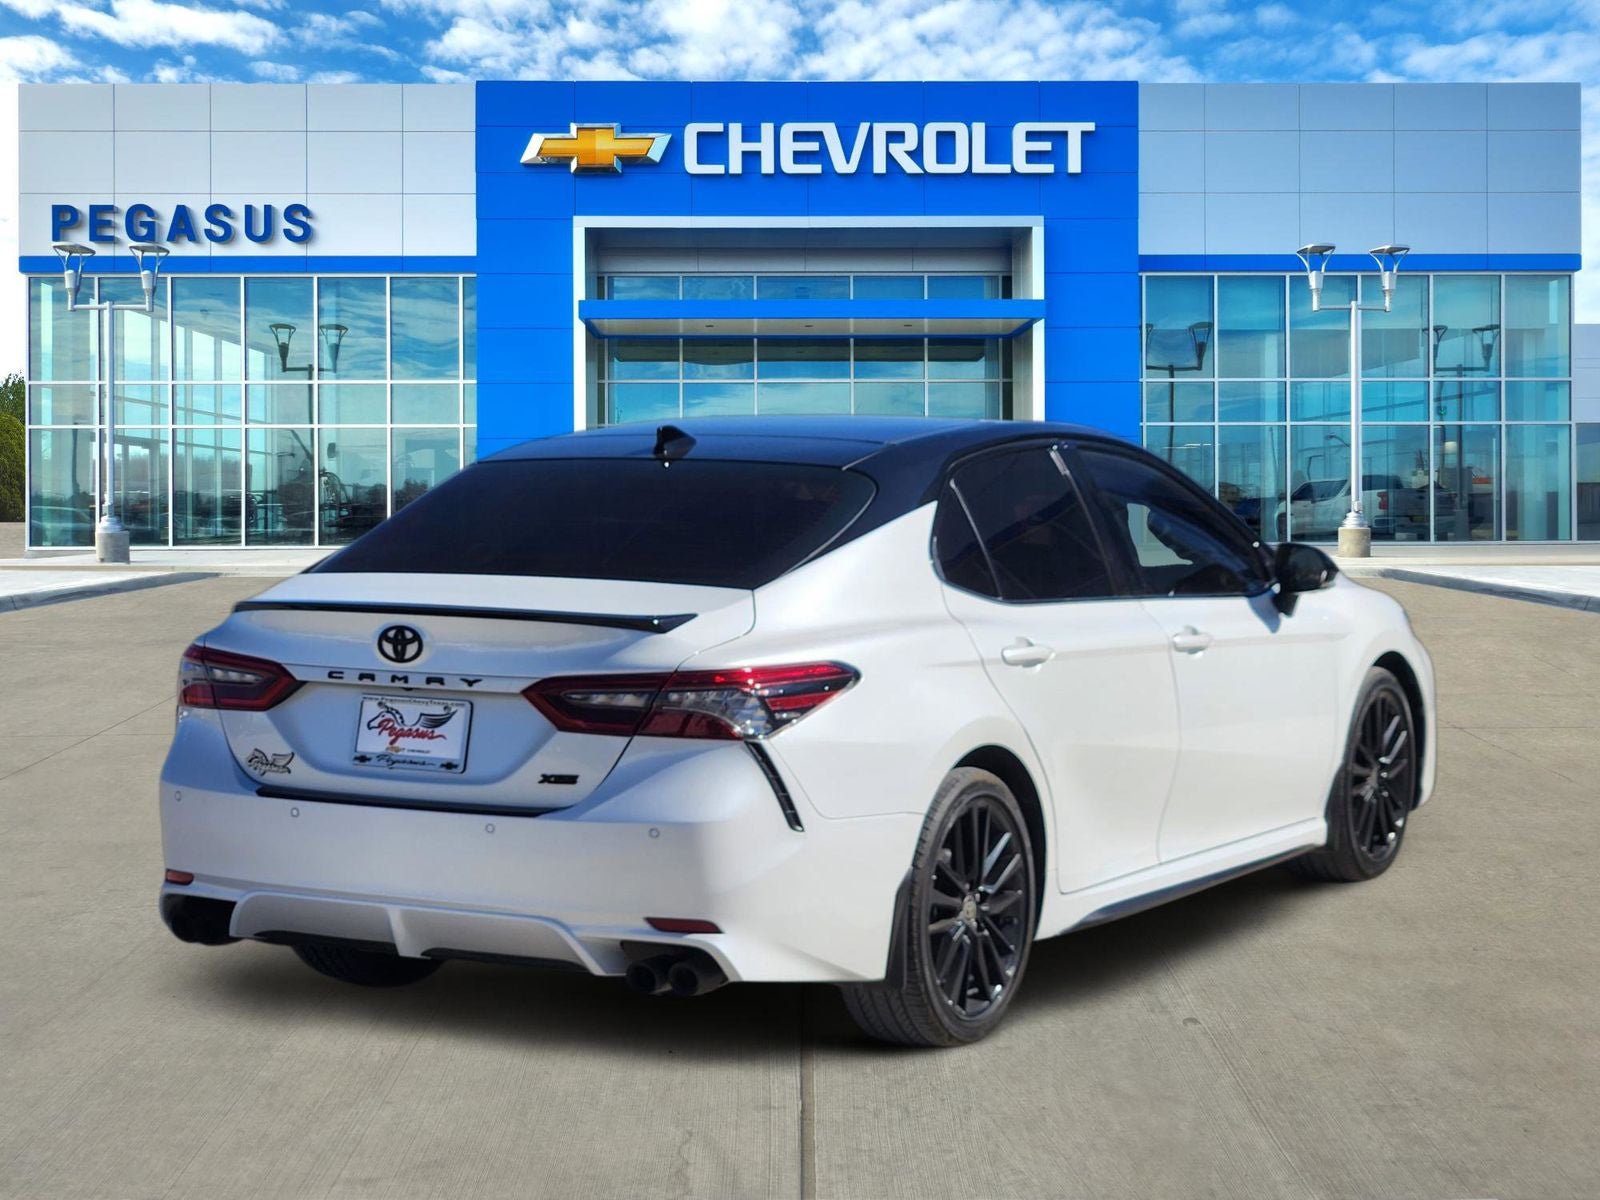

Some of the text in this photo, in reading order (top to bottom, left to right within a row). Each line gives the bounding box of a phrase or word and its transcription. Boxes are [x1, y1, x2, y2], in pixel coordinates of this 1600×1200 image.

[684, 121, 1096, 175] CHEVROLET
[51, 203, 313, 244] PEGASUS
[327, 669, 484, 688] CAMRY
[377, 717, 447, 746] Pegasus
